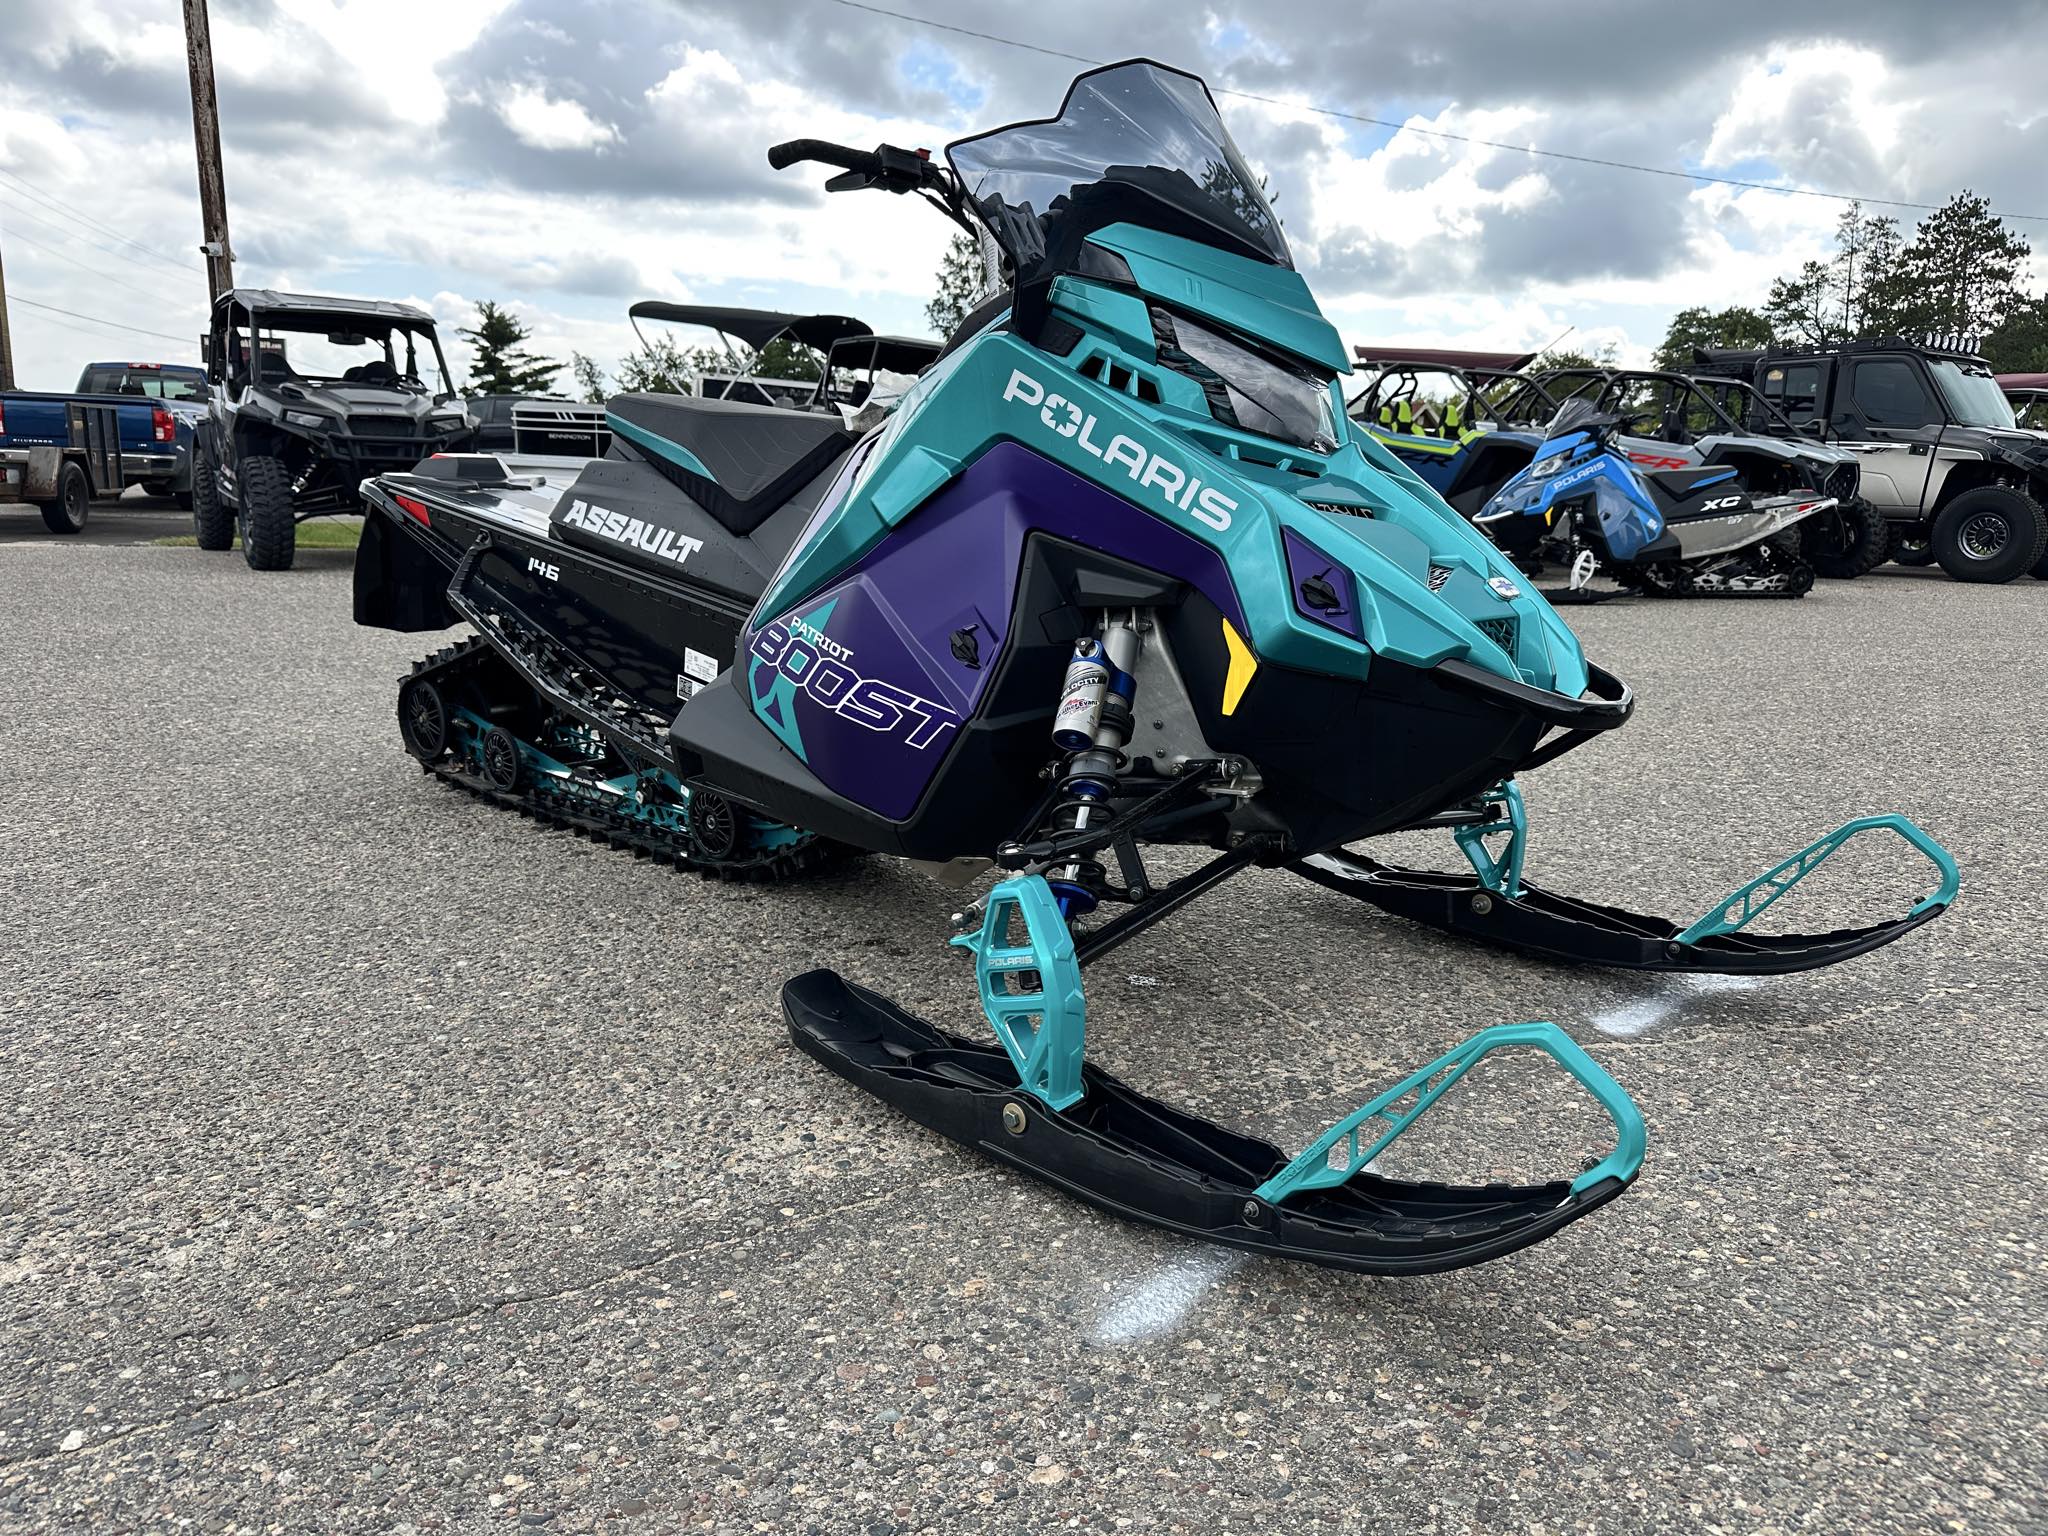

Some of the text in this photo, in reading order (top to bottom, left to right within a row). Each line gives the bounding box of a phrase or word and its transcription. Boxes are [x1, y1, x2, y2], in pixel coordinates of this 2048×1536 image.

[548, 432, 592, 441] BENNINGTON
[1002, 368, 1240, 532] POLARIS
[1552, 460, 1606, 491] POLARIS
[1700, 495, 1742, 512] XC
[562, 498, 705, 565] ASSAULT
[527, 556, 561, 582] 146
[790, 615, 855, 662] PATRIOT
[750, 620, 958, 750] BOOST
[987, 955, 1034, 967] POLARIS
[1276, 1140, 1328, 1187] POLARIS
